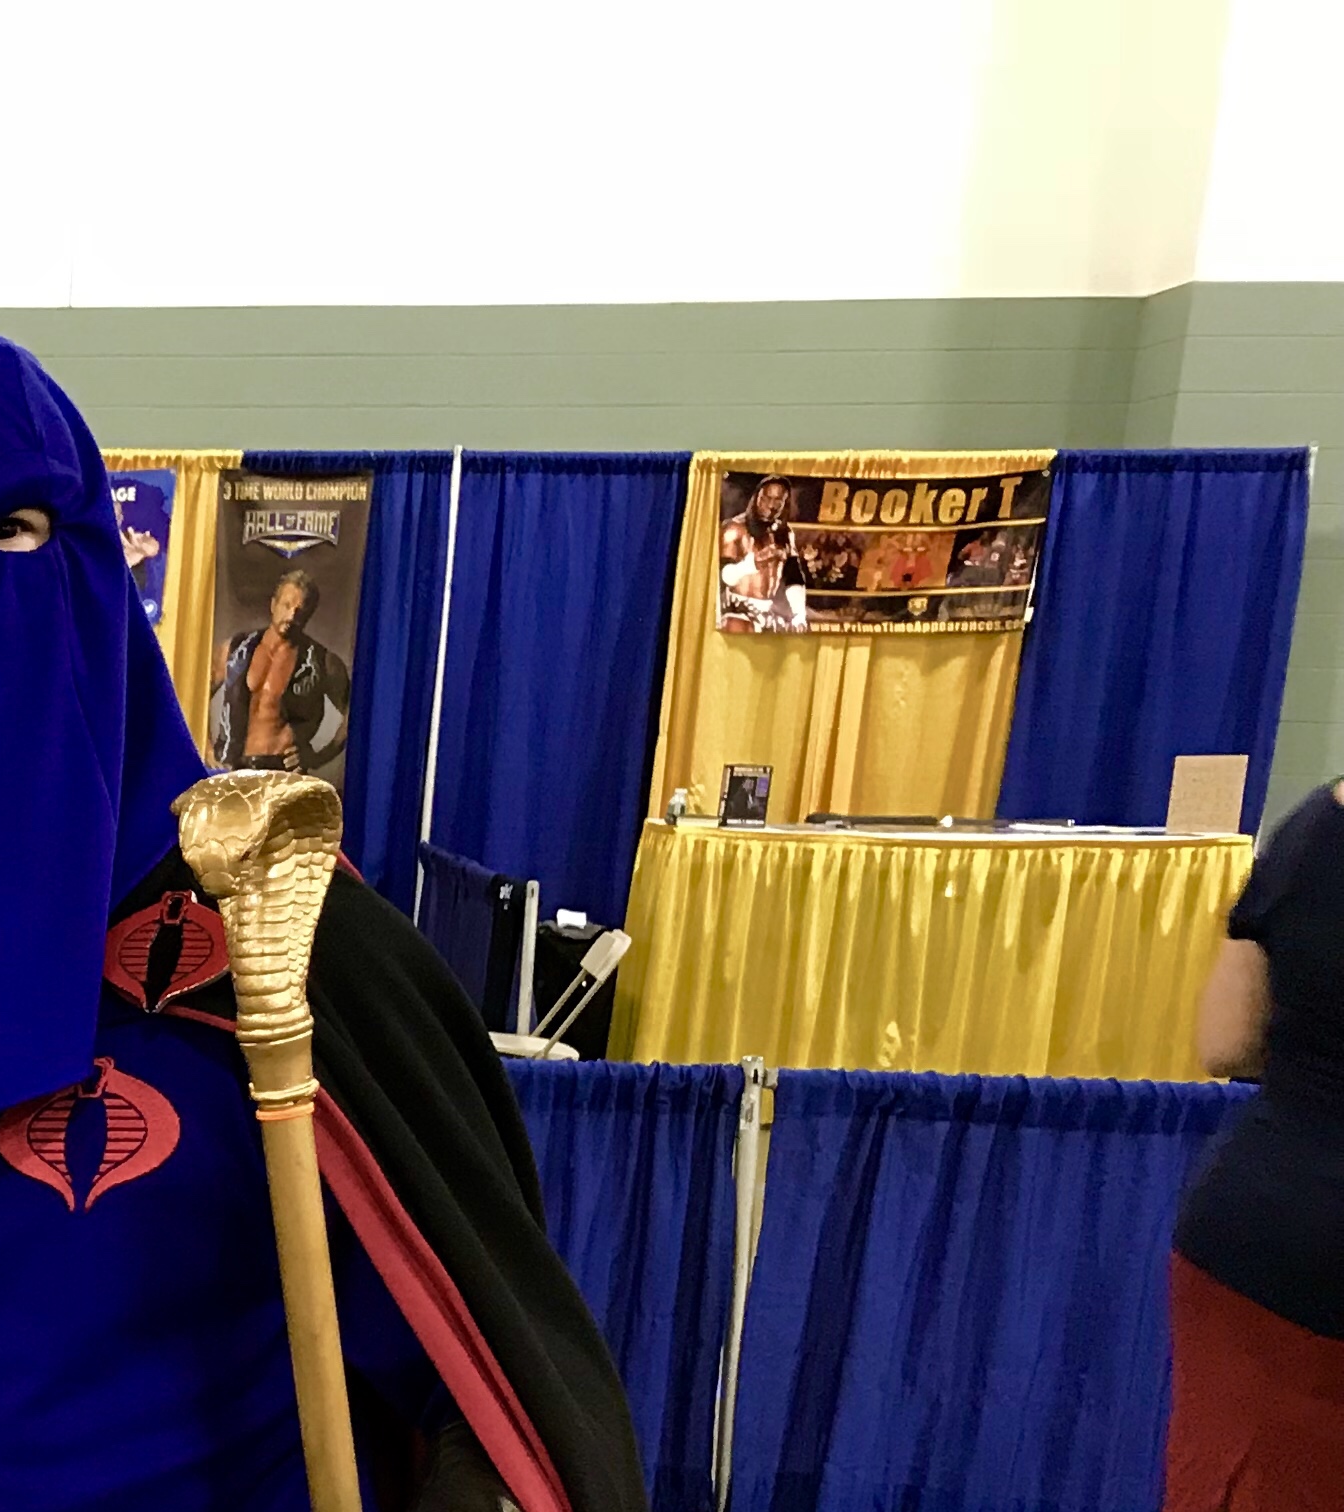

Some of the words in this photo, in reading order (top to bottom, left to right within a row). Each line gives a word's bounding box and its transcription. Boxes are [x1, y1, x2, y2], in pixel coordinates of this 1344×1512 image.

[234, 481, 261, 500] TIME
[262, 481, 304, 500] WORLD
[305, 481, 368, 500] CHAMPION
[817, 480, 989, 525] Booker
[997, 476, 1023, 519] T
[243, 510, 285, 542] HALL
[296, 510, 338, 540] FAME
